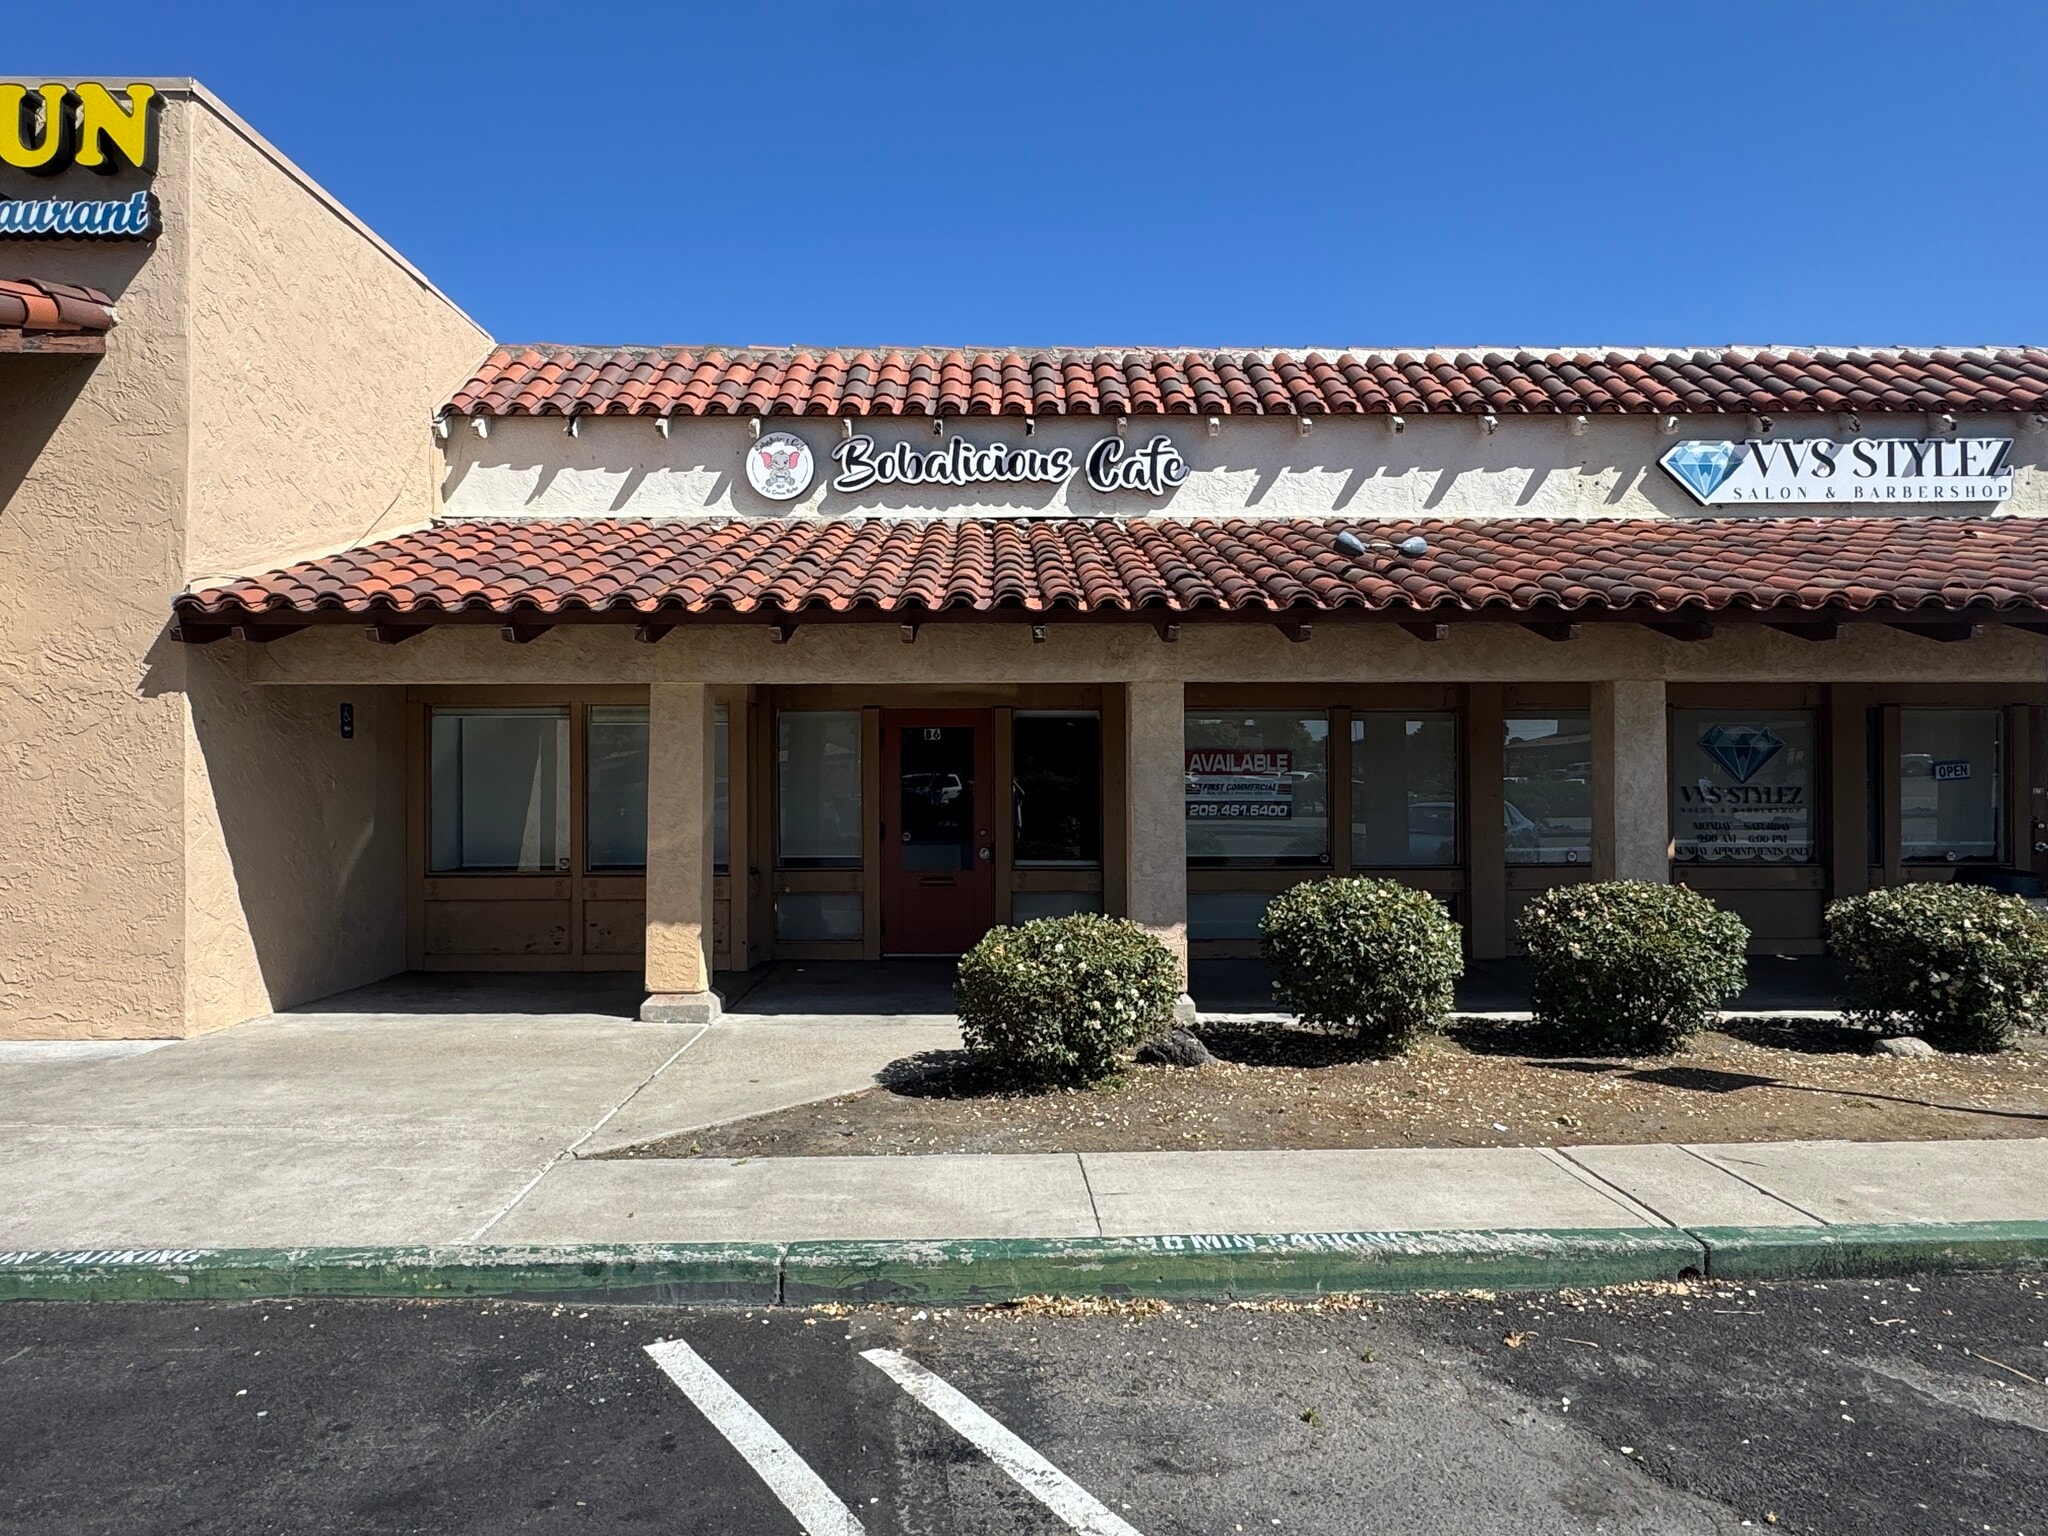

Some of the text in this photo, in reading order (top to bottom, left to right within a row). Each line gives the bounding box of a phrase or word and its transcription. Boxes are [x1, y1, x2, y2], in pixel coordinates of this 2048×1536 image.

[0, 82, 155, 168] UN
[832, 434, 1191, 495] Bobalicious Cafe
[1748, 439, 2014, 478] VVS STYLEZ
[1733, 485, 2009, 500] SALON & BARBERSHOP
[1189, 753, 1289, 772] AVAILABLE
[1938, 764, 1968, 778] OPEN
[1202, 783, 1277, 792] FIRST COMMERCIAL
[1728, 786, 1803, 804] STYLEZ
[1189, 804, 1288, 817] 209.461.6400
[1693, 821, 1790, 831] MONDAY SATURDAY
[1748, 834, 1769, 843] 6:00
[1772, 834, 1788, 843] PM
[1675, 846, 1811, 855] SUNDAY APPOINTMENTS ONLY
[1189, 1234, 1256, 1249] MIN
[38, 1248, 201, 1265] PARKING
